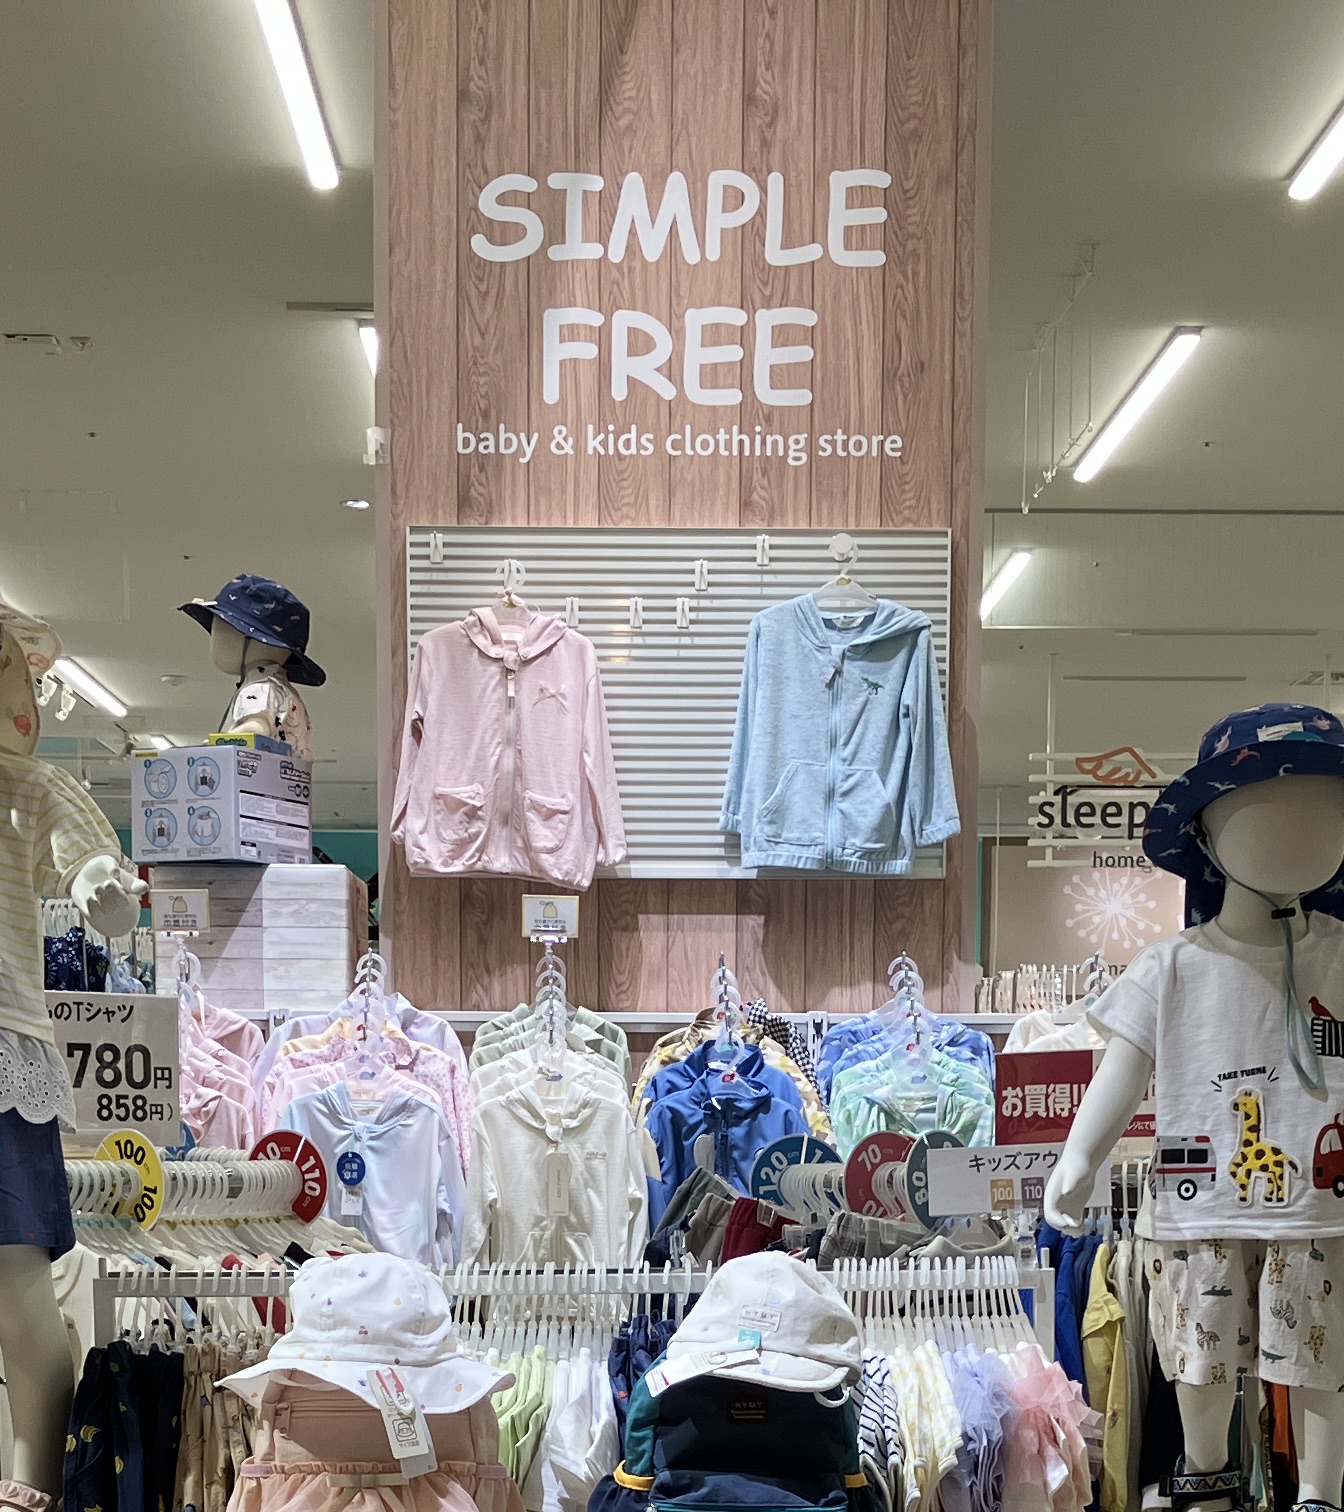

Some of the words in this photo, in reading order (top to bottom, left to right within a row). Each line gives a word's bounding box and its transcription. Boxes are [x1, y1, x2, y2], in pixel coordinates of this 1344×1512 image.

[470, 168, 892, 268] SIMPLE
[542, 306, 819, 407] FREE
[456, 423, 540, 464] baby
[550, 426, 575, 457] &
[588, 424, 654, 457] kids
[666, 424, 809, 466] clothing
[818, 429, 903, 458] store
[1092, 850, 1146, 869] home
[1217, 1069, 1238, 1082] TAKE
[114, 1138, 146, 1167] 100
[858, 1143, 883, 1172] 70
[968, 1150, 1058, 1173] キッズアウ
[300, 1155, 321, 1197] 110
[758, 1151, 789, 1195] 120
[912, 1170, 929, 1206] 80
[133, 1184, 159, 1224] 100
[991, 1187, 1013, 1203] 100
[1023, 1185, 1043, 1200] 110
